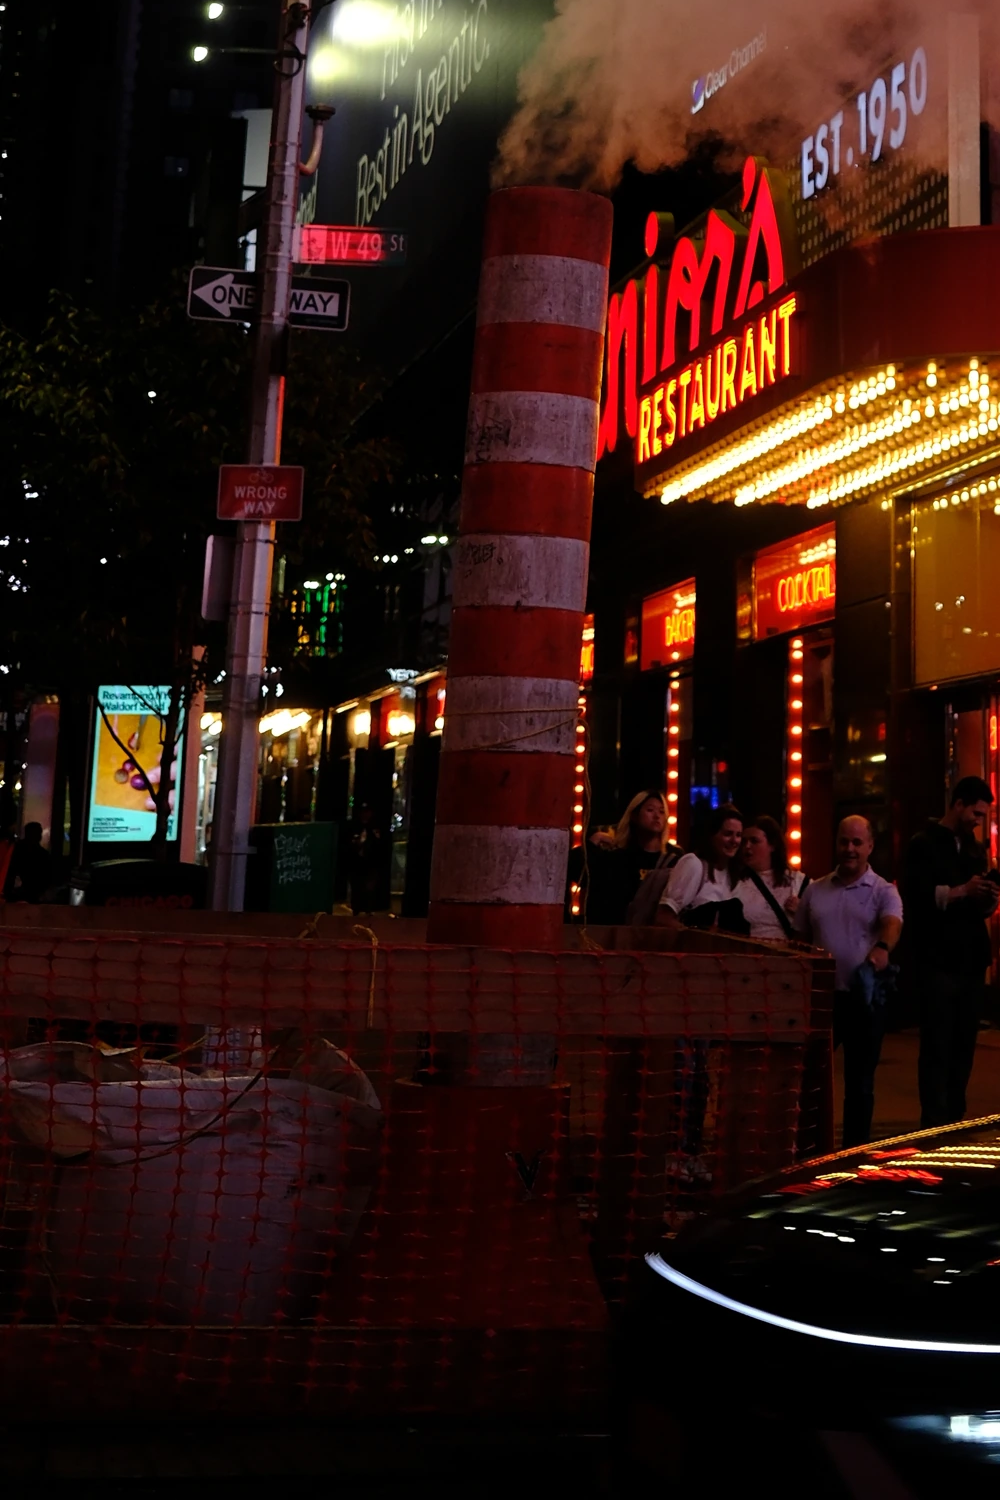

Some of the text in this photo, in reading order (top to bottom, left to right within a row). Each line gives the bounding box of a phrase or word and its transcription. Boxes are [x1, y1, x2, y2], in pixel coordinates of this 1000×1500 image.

[703, 62, 729, 100] Clear
[354, 127, 392, 228] Best
[390, 104, 408, 193] in
[331, 231, 405, 261] W 49 St
[596, 156, 786, 461] nior's
[636, 293, 798, 465] RESTAURANT
[234, 485, 288, 500] WRONG
[243, 501, 276, 514] WAY
